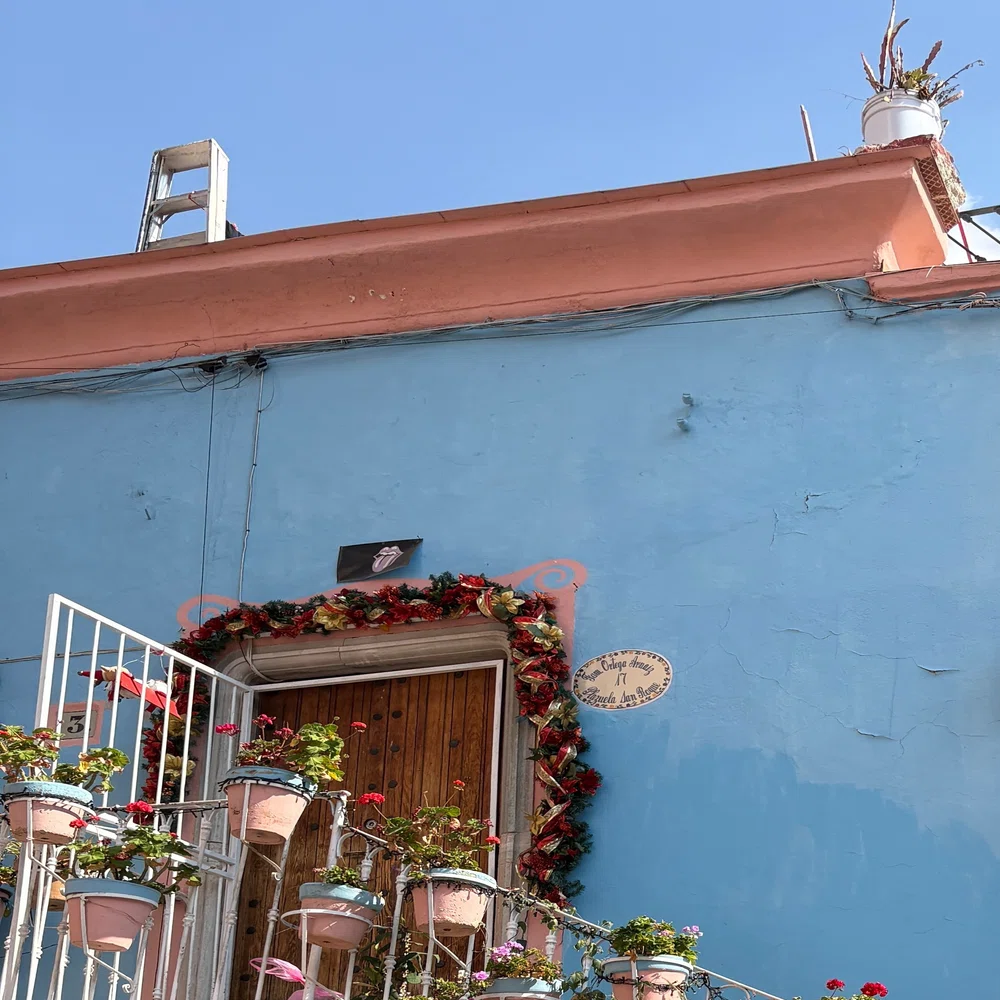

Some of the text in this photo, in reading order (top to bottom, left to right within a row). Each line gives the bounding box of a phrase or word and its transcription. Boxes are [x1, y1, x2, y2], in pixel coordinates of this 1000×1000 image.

[601, 658, 627, 672] Ortega
[615, 673, 627, 686] 17
[582, 682, 661, 705] Plazuela San Roque
[67, 715, 85, 733] 3
